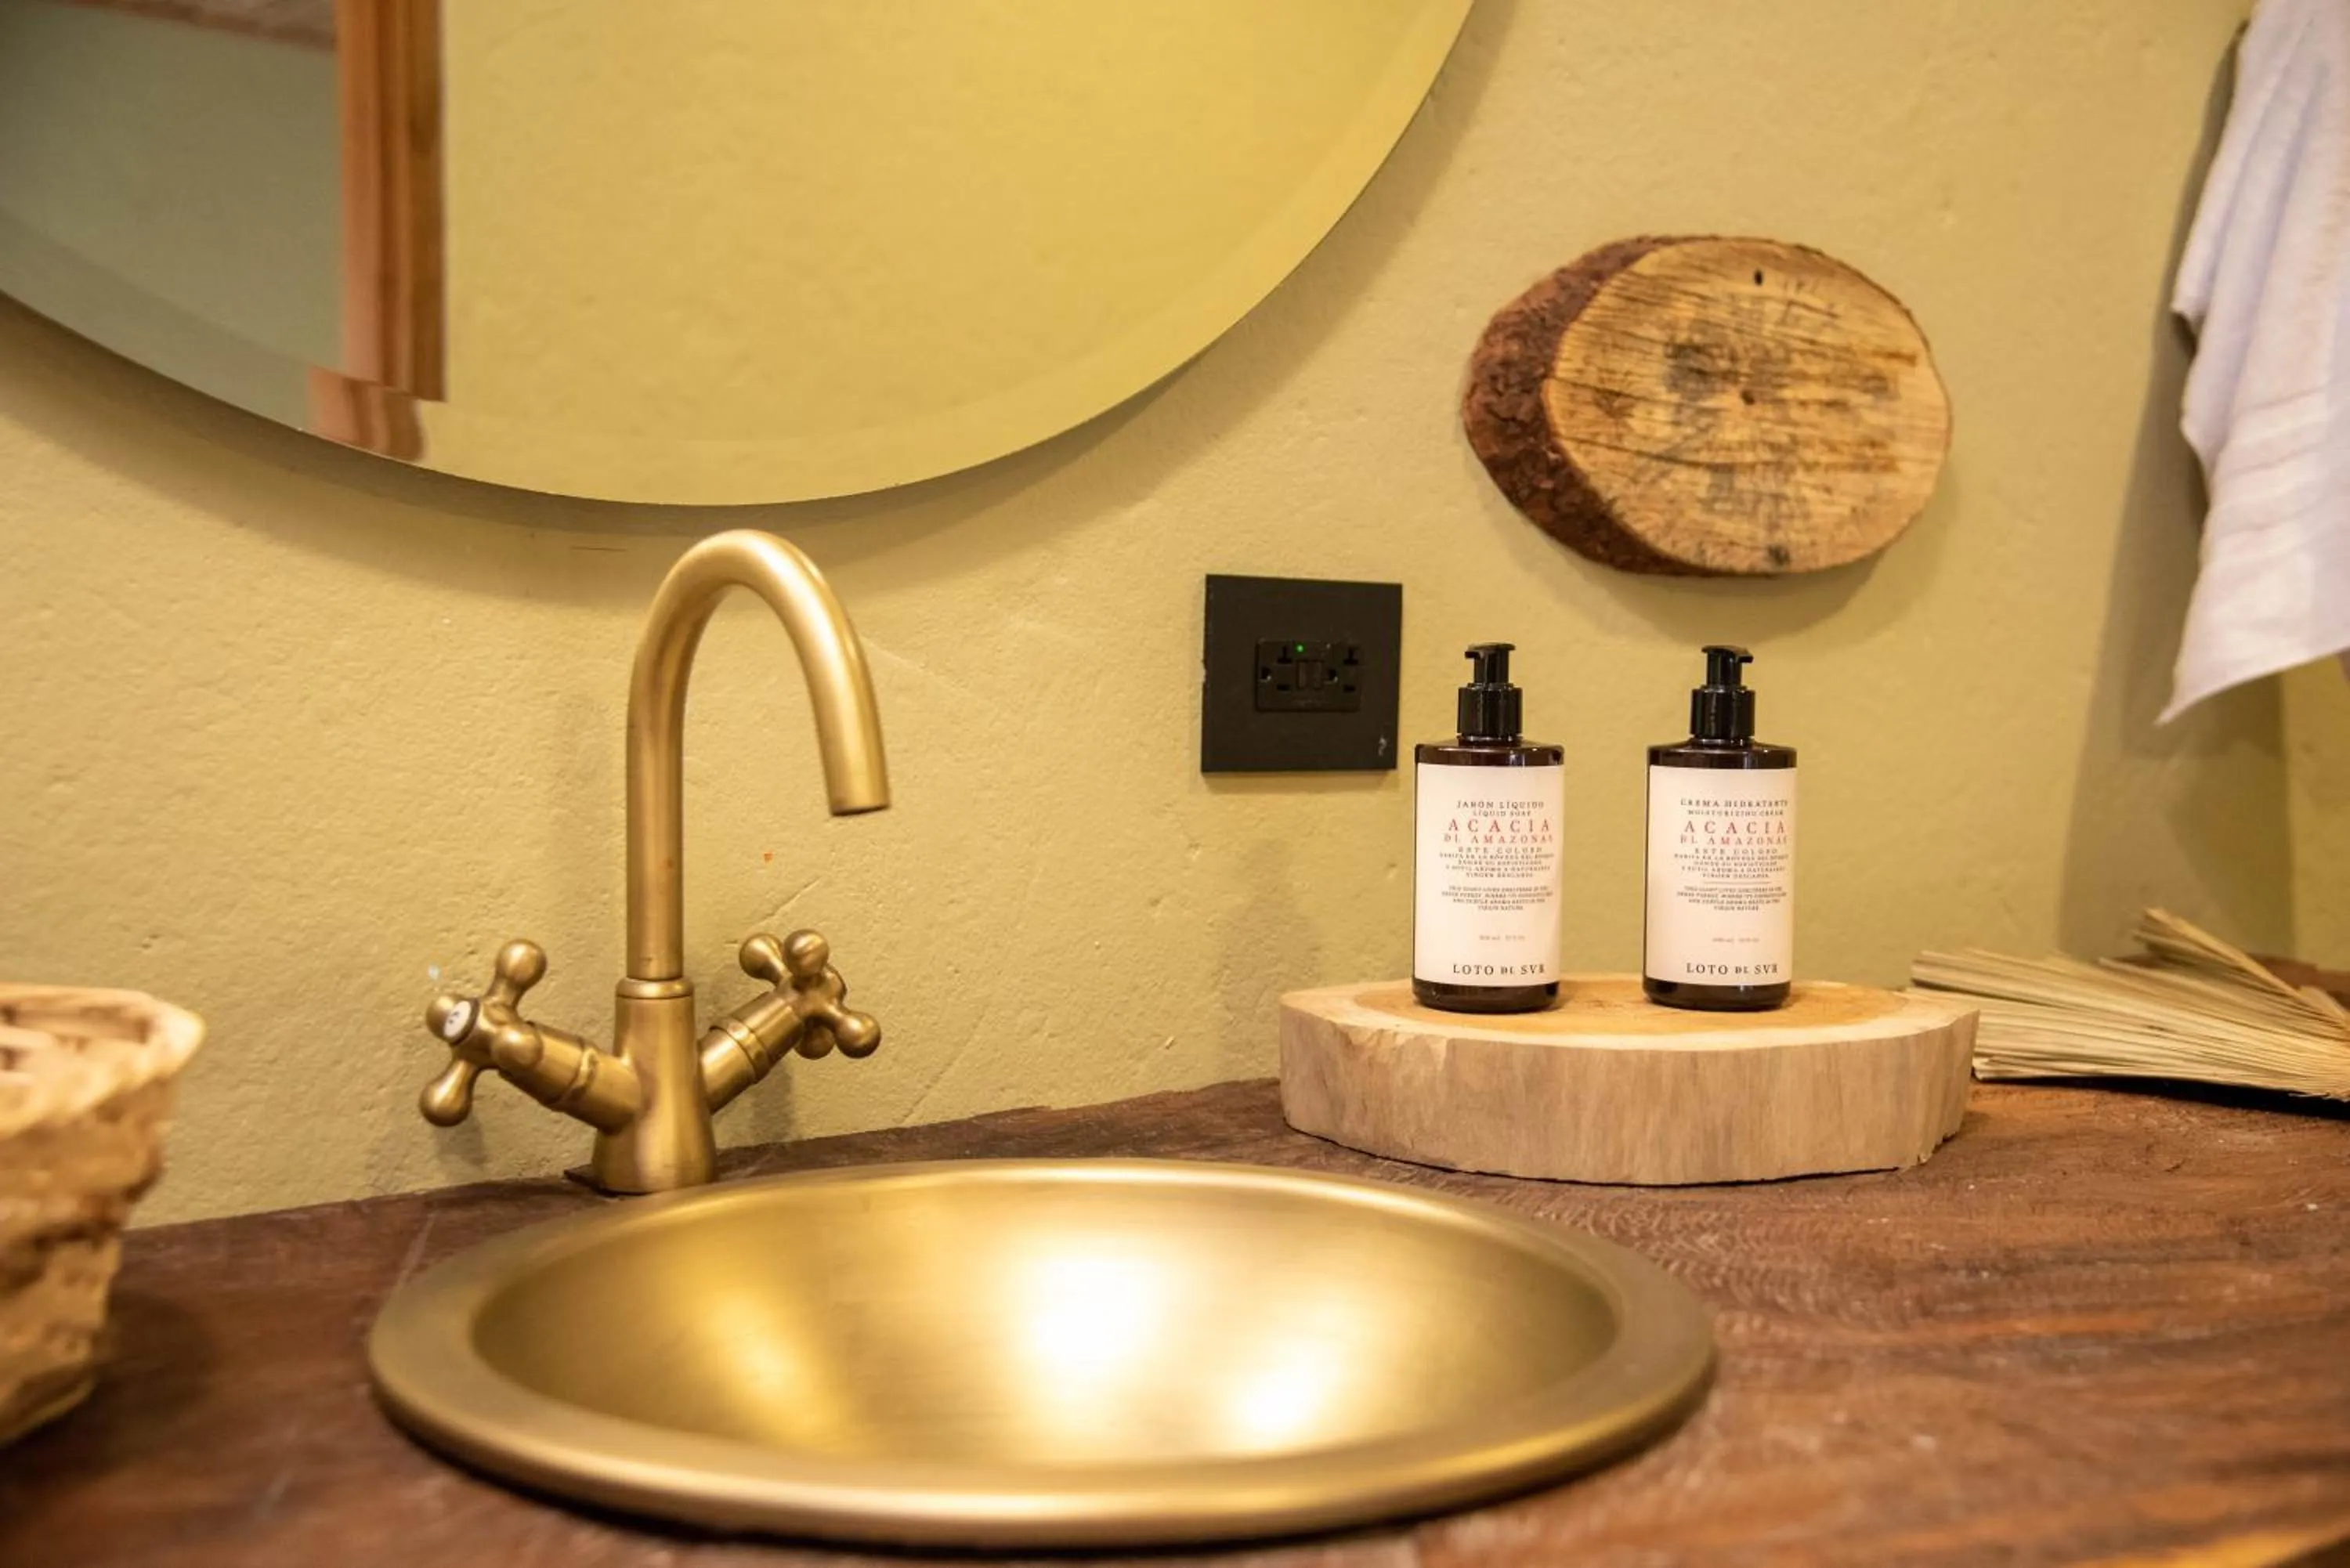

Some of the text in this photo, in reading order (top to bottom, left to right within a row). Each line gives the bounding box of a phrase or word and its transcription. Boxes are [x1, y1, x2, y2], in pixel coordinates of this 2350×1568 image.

[1448, 818, 1549, 833] ACACIA
[1684, 820, 1785, 834] ACACIA
[1453, 964, 1494, 975] LOTO
[1687, 963, 1728, 975] LOTO
